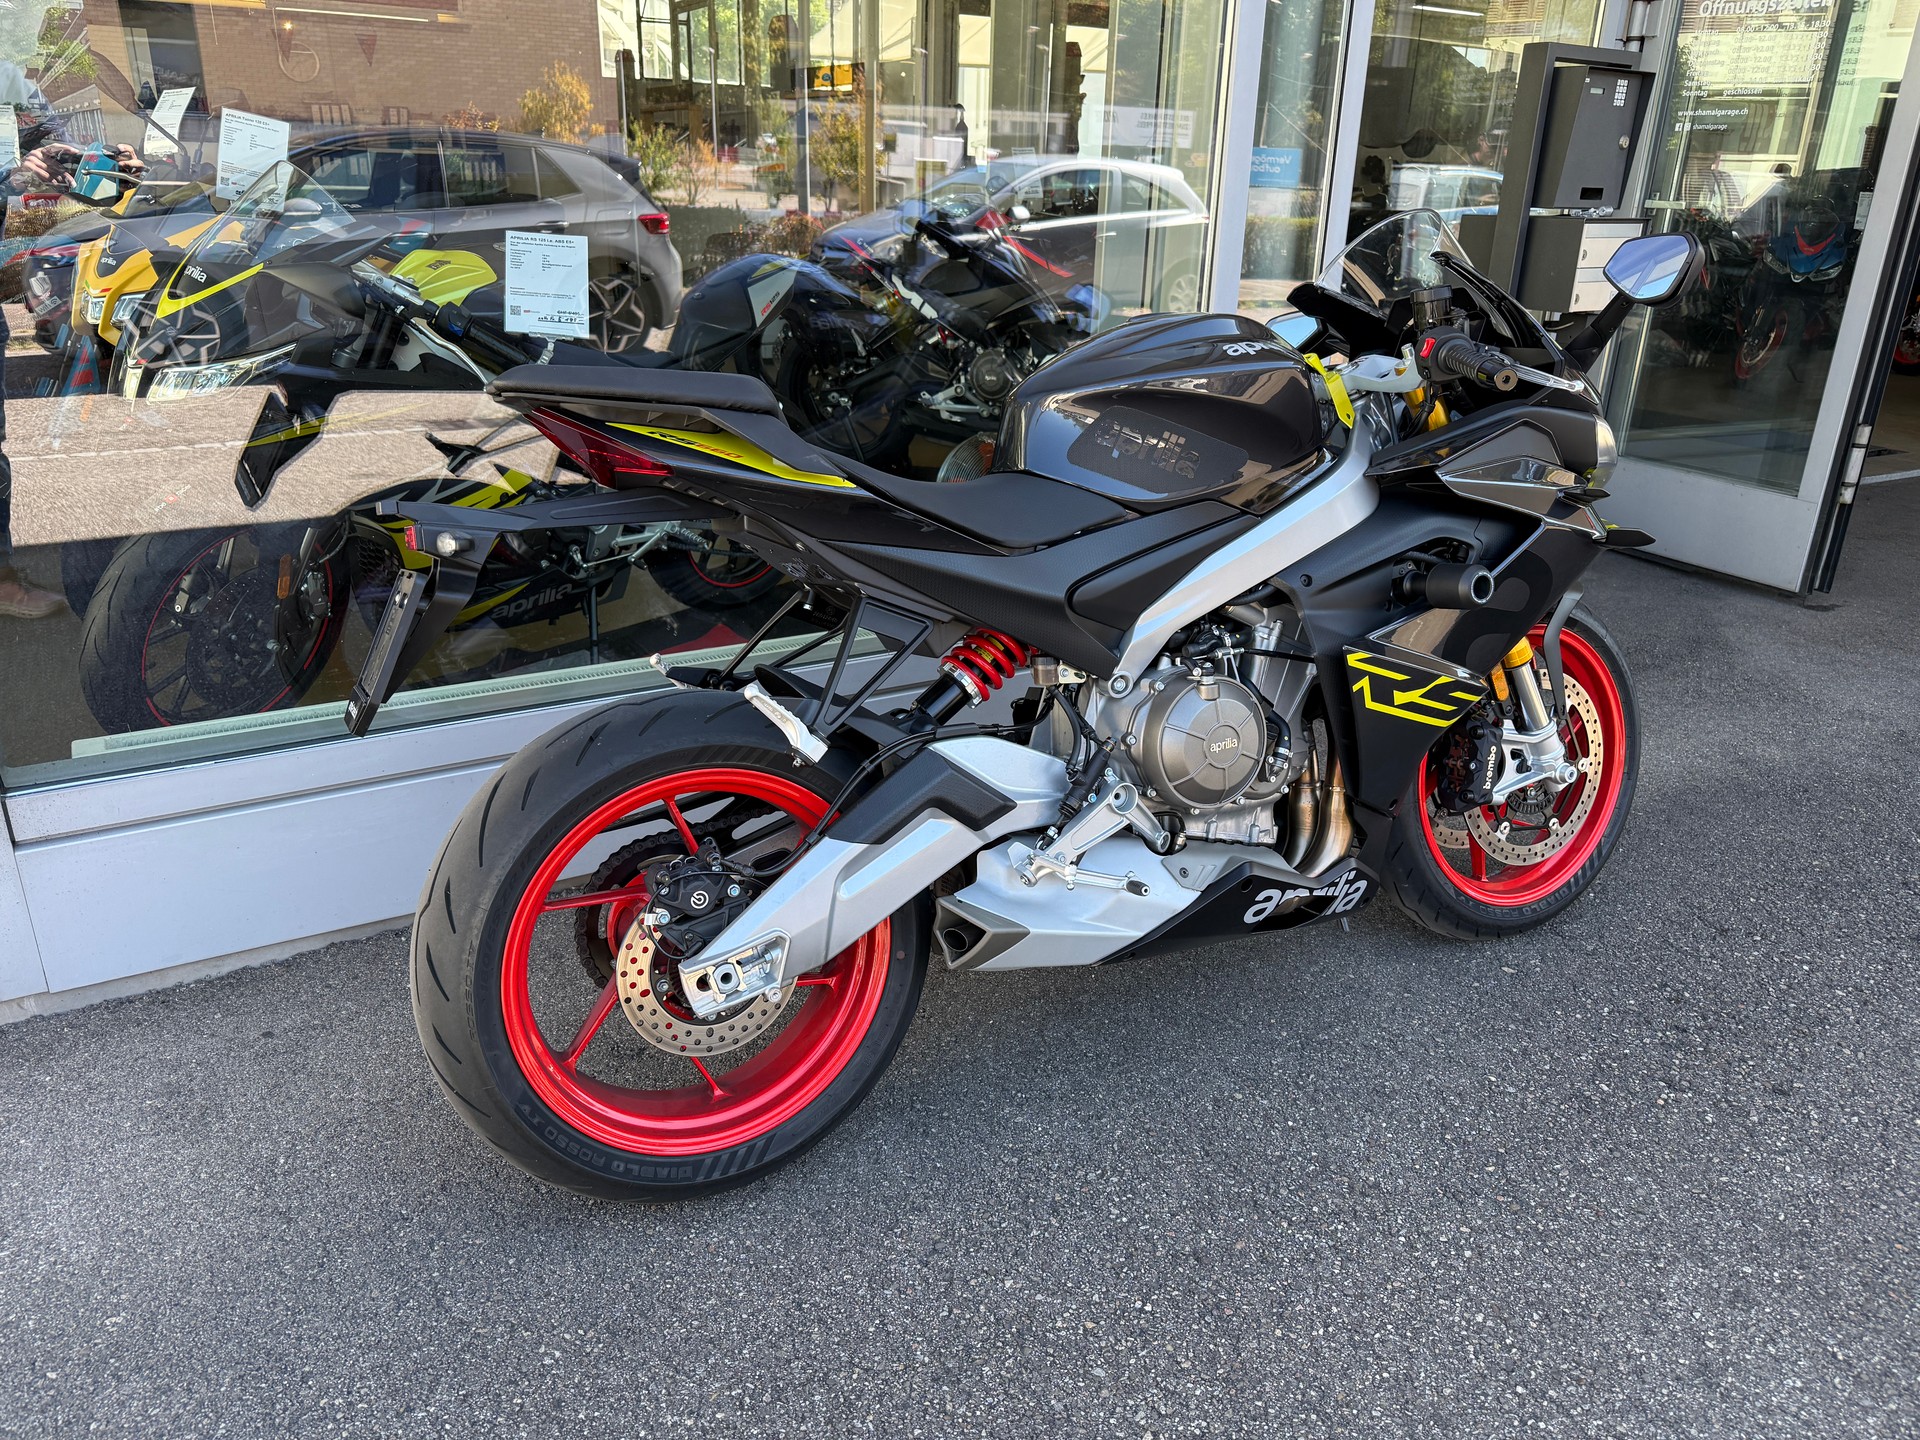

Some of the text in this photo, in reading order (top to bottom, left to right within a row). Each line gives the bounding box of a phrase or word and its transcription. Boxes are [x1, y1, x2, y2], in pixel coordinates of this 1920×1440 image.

[1682, 87, 1762, 97] Sonntag geschlossen
[1678, 107, 1749, 117] www.shamalgarage.ch
[1692, 122, 1728, 131] shamalgarage
[184, 264, 208, 284] prilia
[491, 583, 573, 619] aprilia
[1210, 737, 1238, 753] aprilia
[1482, 745, 1497, 790] brembo
[543, 1125, 606, 1169] ROSSO
[610, 1160, 694, 1180] DIABLO
